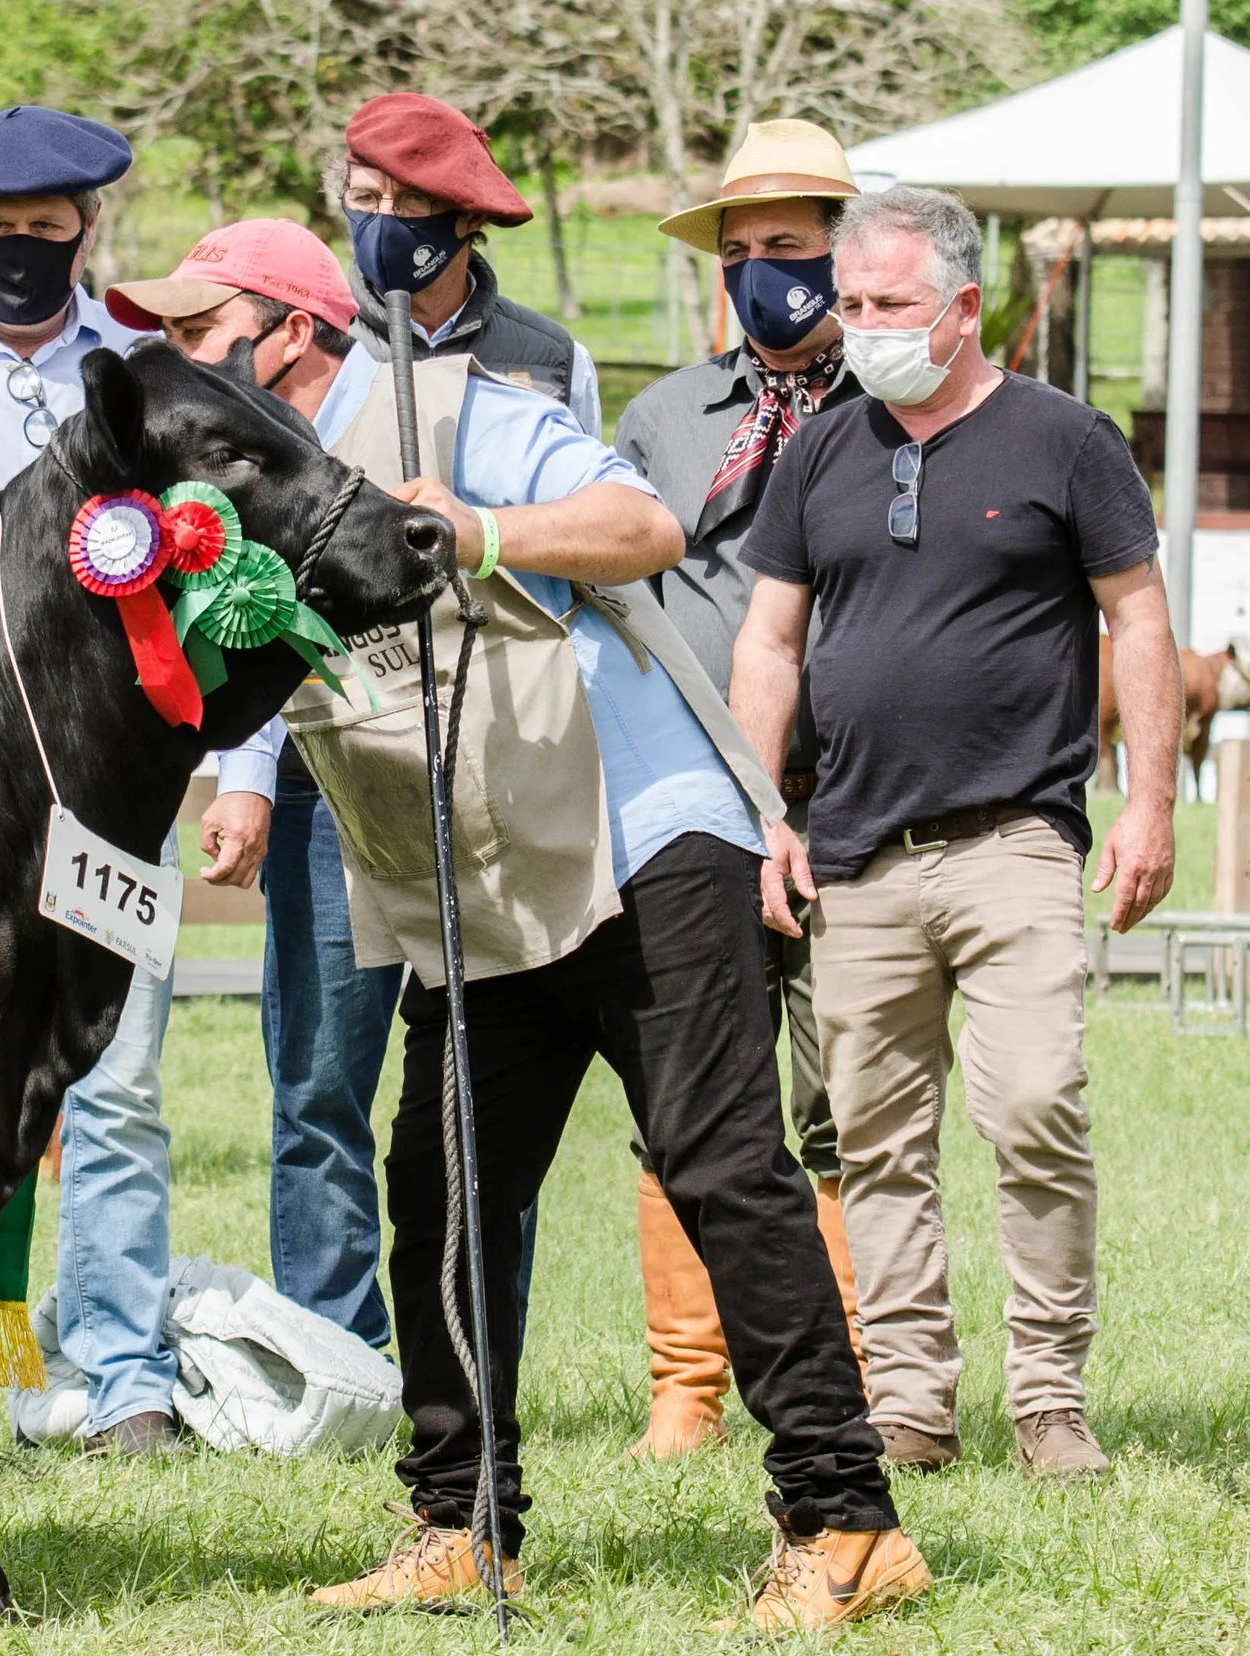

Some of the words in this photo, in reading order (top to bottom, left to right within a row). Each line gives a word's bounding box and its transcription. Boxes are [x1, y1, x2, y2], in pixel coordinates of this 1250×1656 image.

[789, 293, 823, 322] BRANGUS
[367, 643, 421, 678] SUL
[71, 851, 158, 926] 1175
